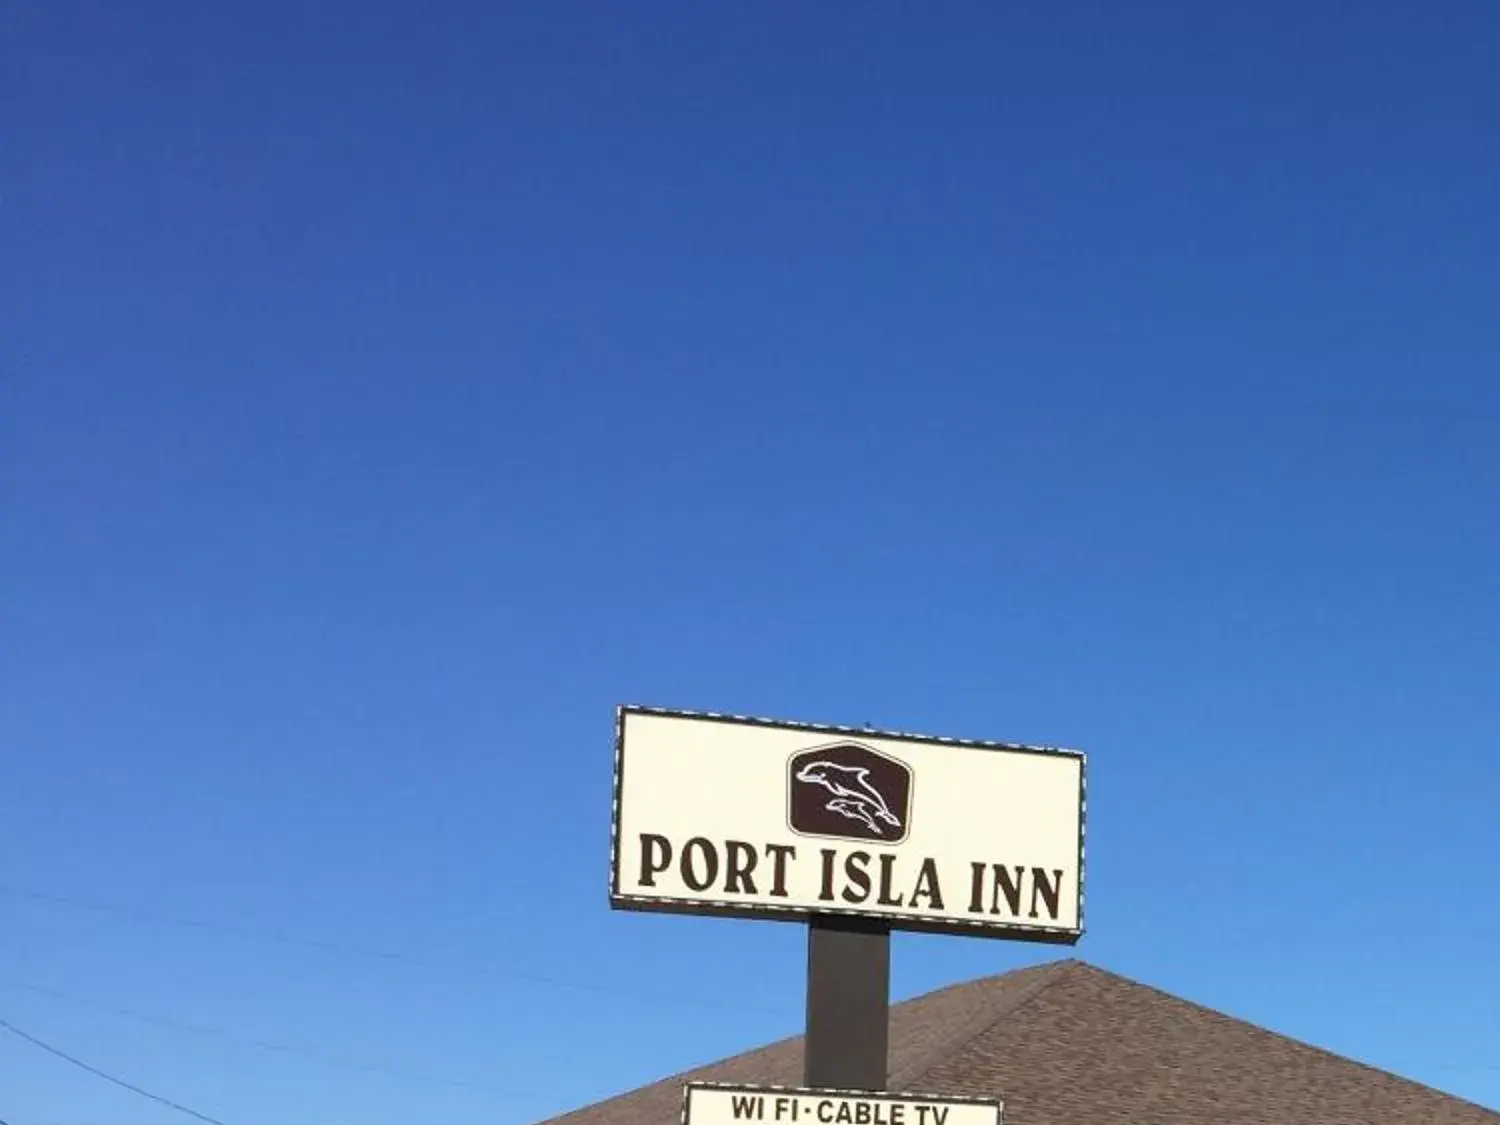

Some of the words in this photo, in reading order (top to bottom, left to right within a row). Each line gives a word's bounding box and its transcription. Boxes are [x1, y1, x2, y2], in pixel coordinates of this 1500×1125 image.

[637, 833, 796, 898] PORT
[818, 848, 945, 911] ISLA
[967, 861, 1064, 920] INN
[731, 1095, 764, 1121] WI
